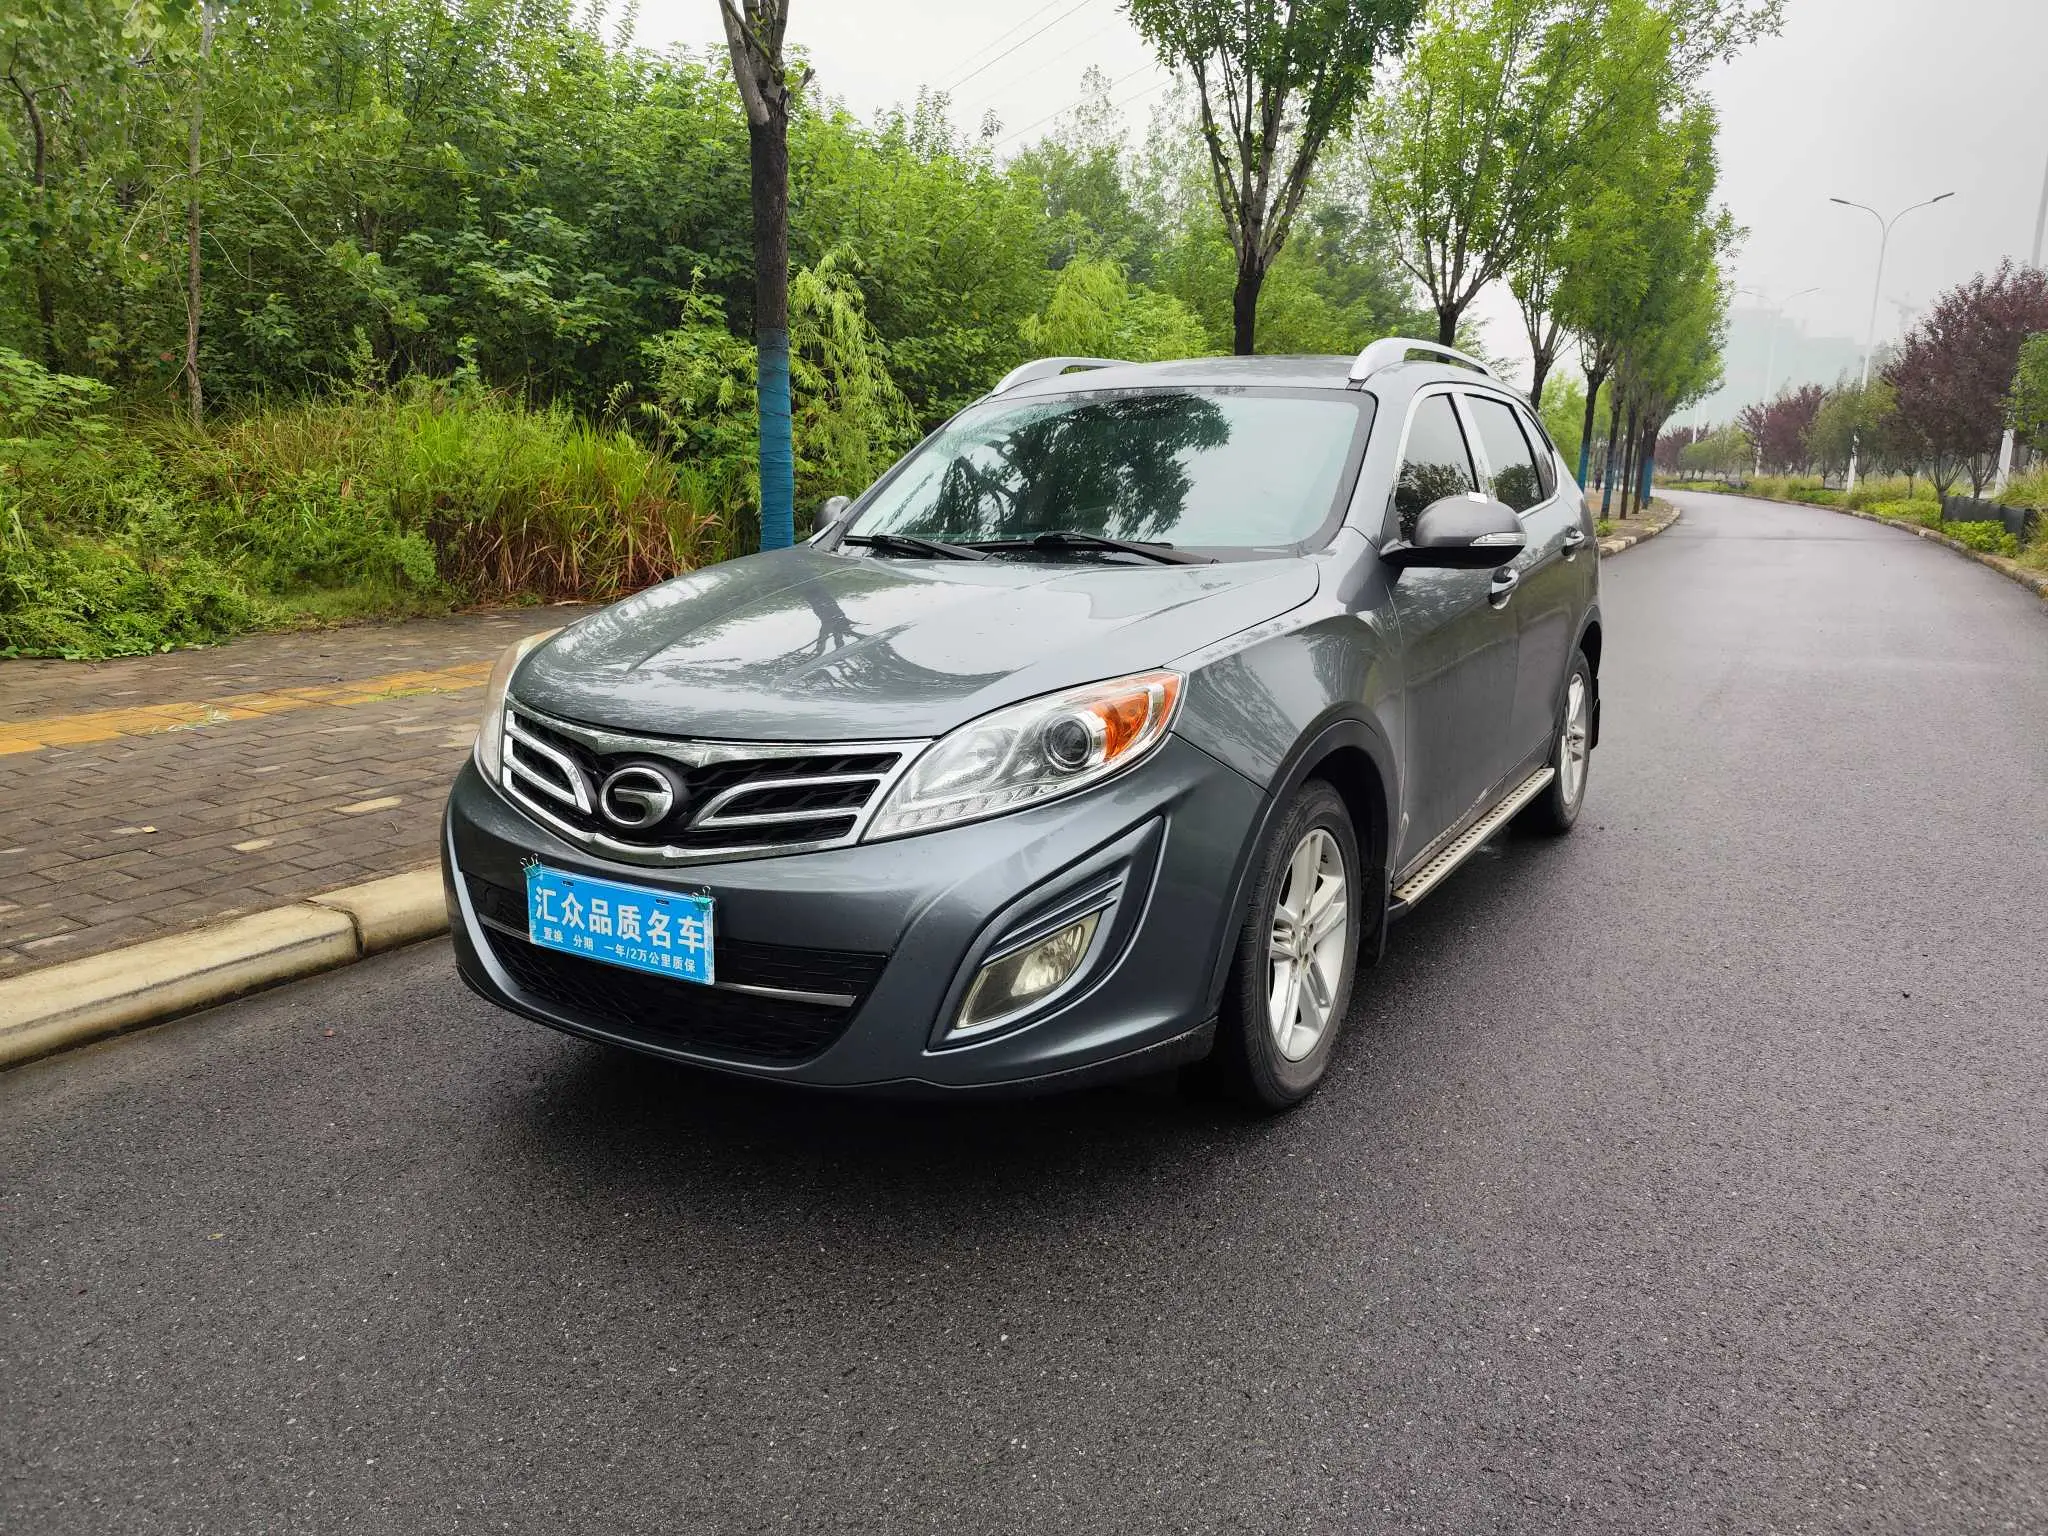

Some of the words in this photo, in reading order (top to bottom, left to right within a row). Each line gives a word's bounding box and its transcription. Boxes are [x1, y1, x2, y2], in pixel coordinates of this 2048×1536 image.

[535, 886, 706, 954] 汇众品质名车
